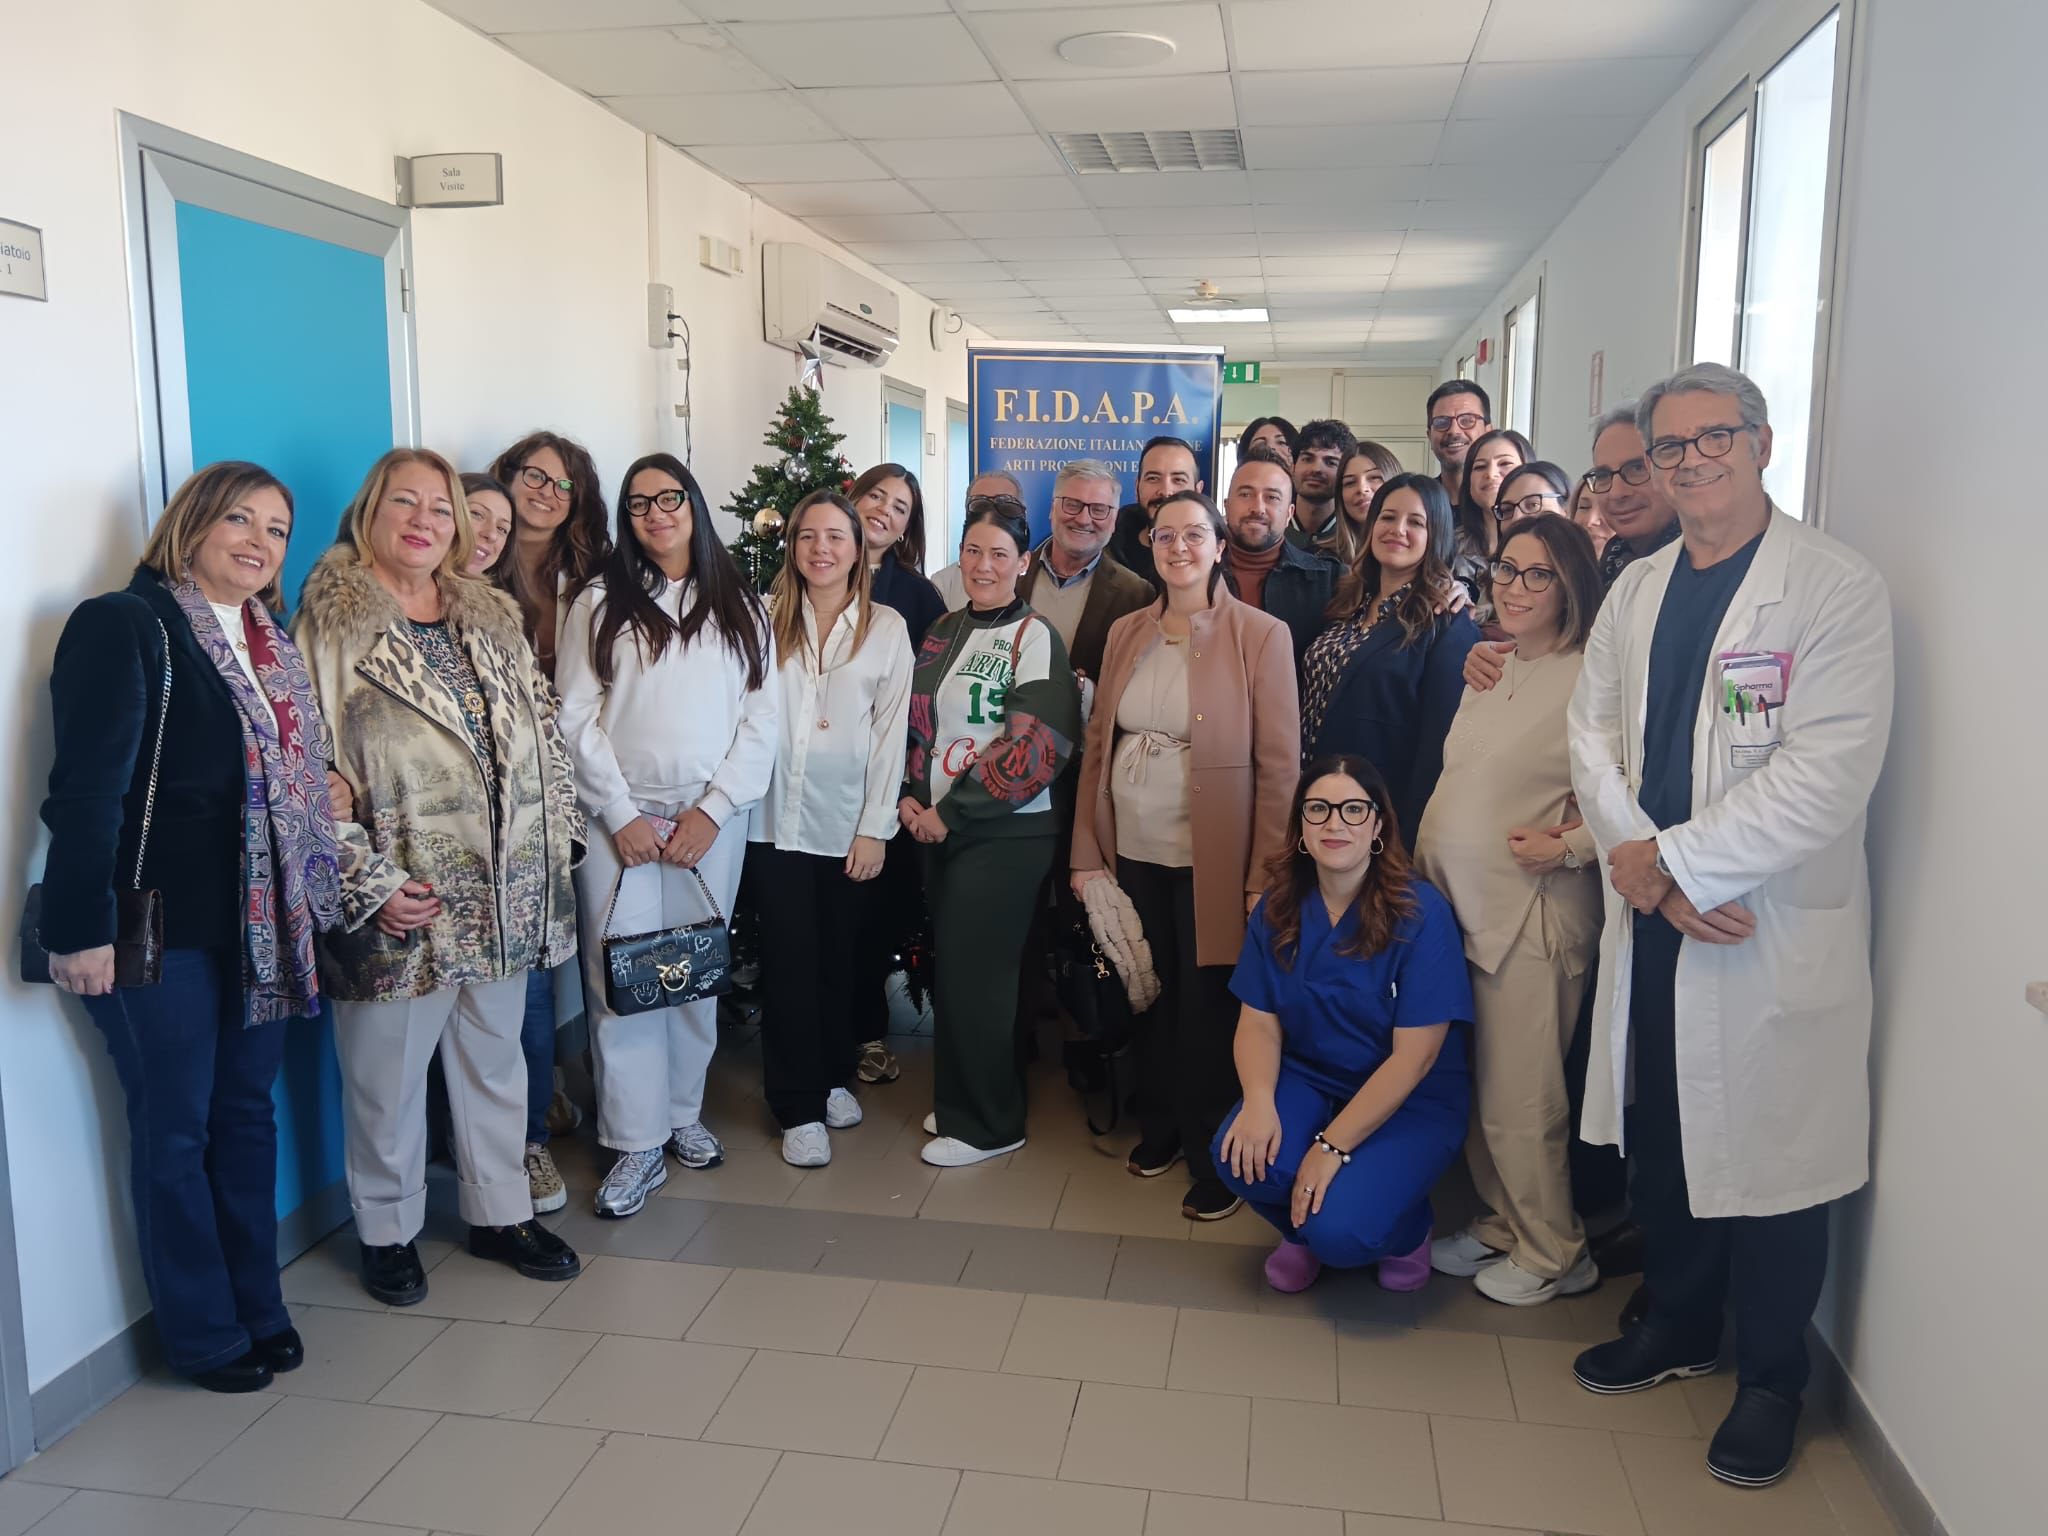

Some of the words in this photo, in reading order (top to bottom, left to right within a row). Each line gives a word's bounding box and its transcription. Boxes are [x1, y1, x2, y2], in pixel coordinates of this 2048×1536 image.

[442, 167, 461, 177] Sala
[440, 181, 465, 191] Visite
[0, 243, 31, 261] iatoio
[993, 388, 1199, 425] F.I.D.A.P.A.
[990, 437, 1087, 451] FEDERAZIONE
[1090, 438, 1144, 451] ITALIAN
[1004, 459, 1036, 472] ARTI
[967, 682, 1009, 724] 15
